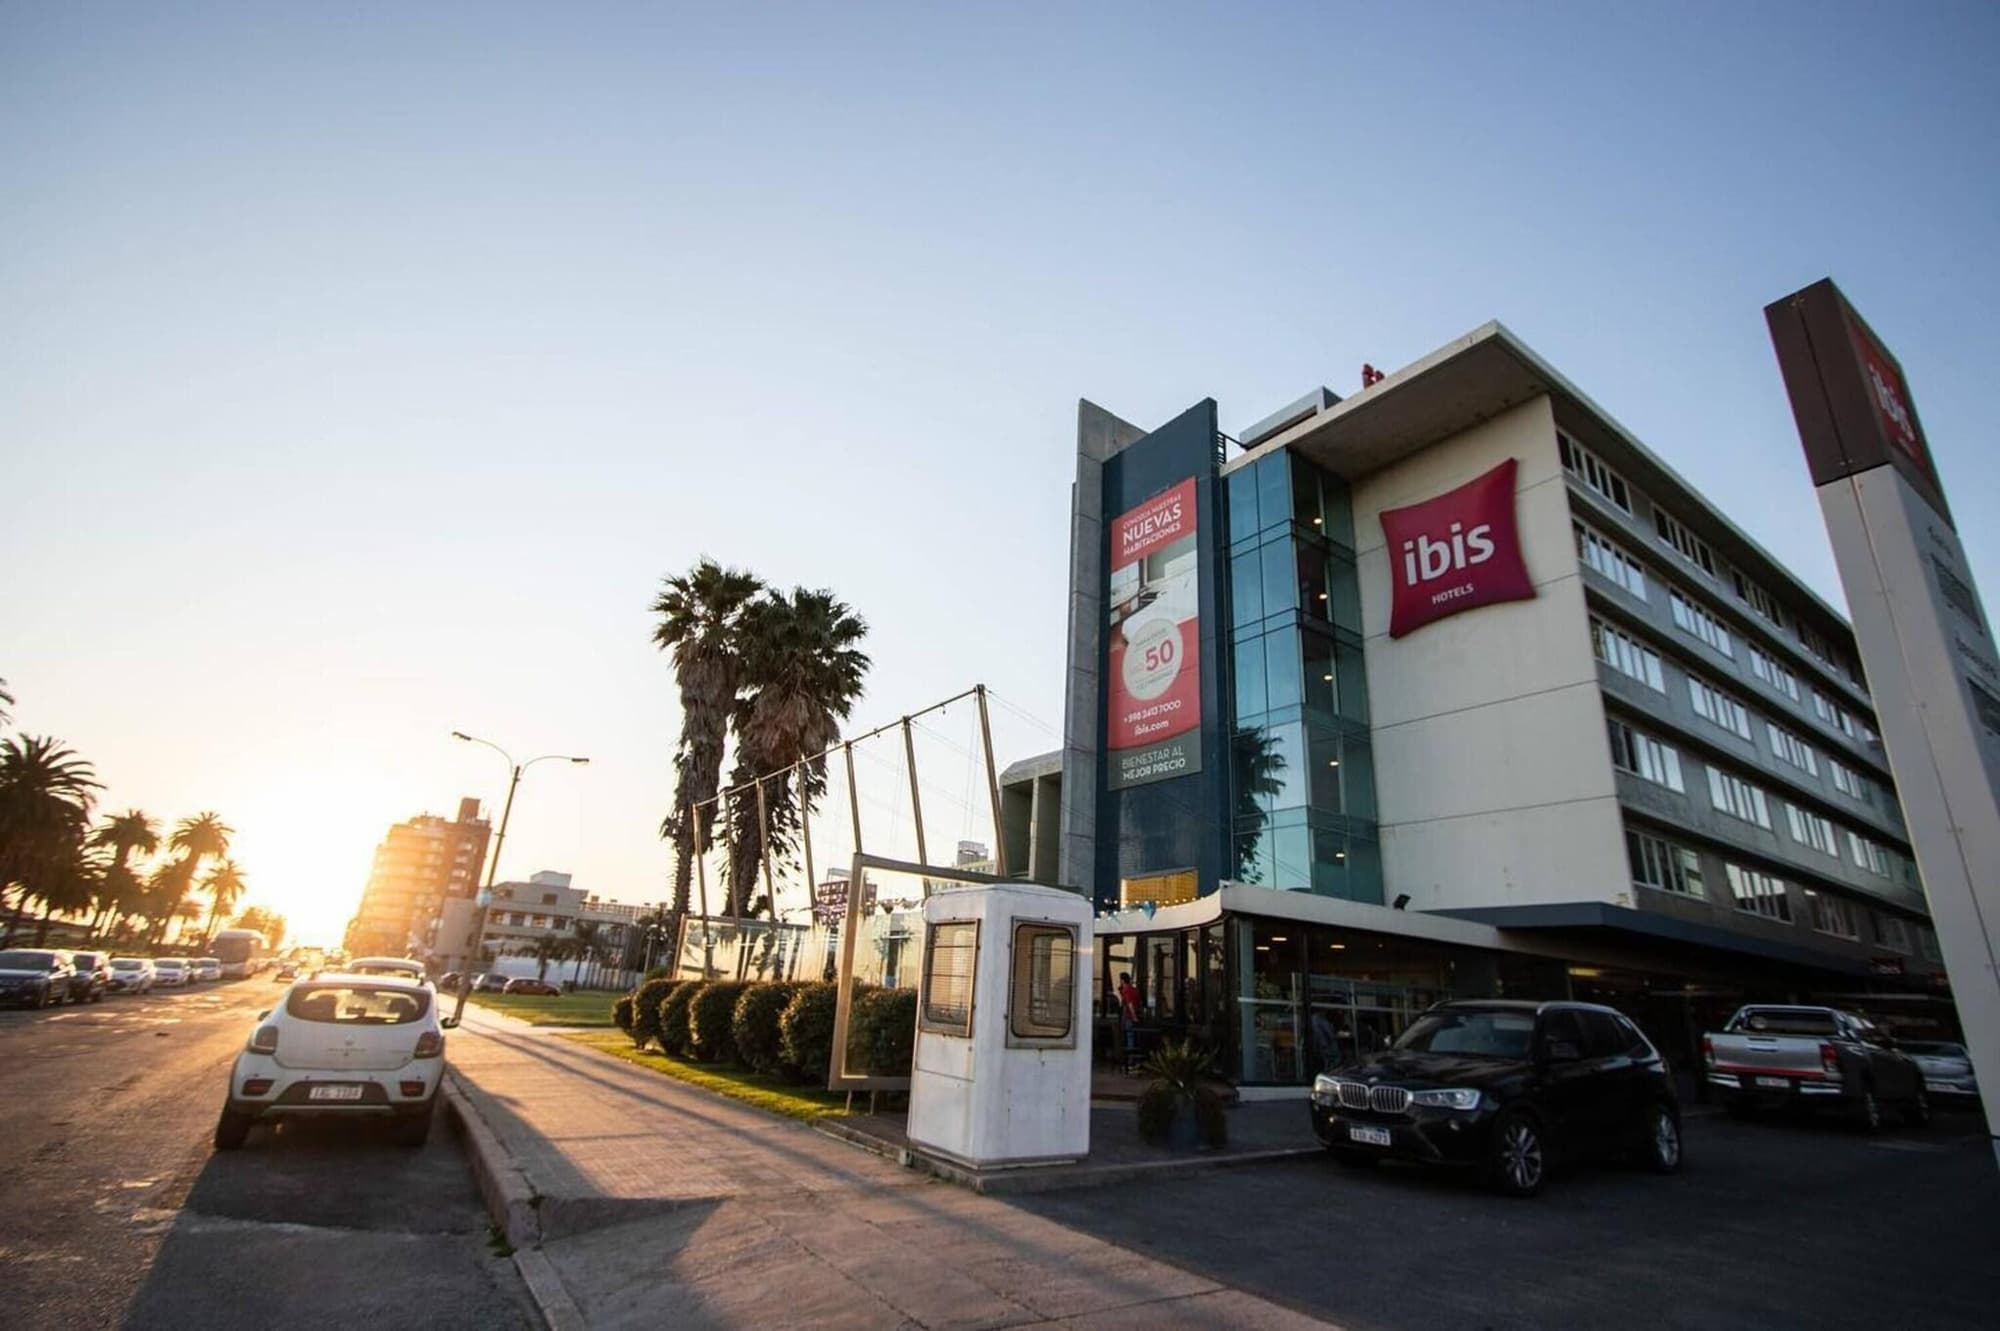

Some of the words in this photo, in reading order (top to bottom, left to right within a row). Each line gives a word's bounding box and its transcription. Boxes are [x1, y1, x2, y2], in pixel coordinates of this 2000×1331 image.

[1123, 503, 1182, 546] NUEVAS
[1123, 521, 1181, 557] HABITACIONES
[1403, 521, 1495, 586] ibis
[1431, 582, 1474, 605] HOTELS
[1146, 639, 1174, 671] 50
[1134, 720, 1169, 736] ibis.com
[1122, 748, 1170, 769] BIENESTAR
[1172, 745, 1184, 757] AL
[1123, 766, 1152, 780] MEJOR
[1153, 758, 1186, 774] PRECIO
